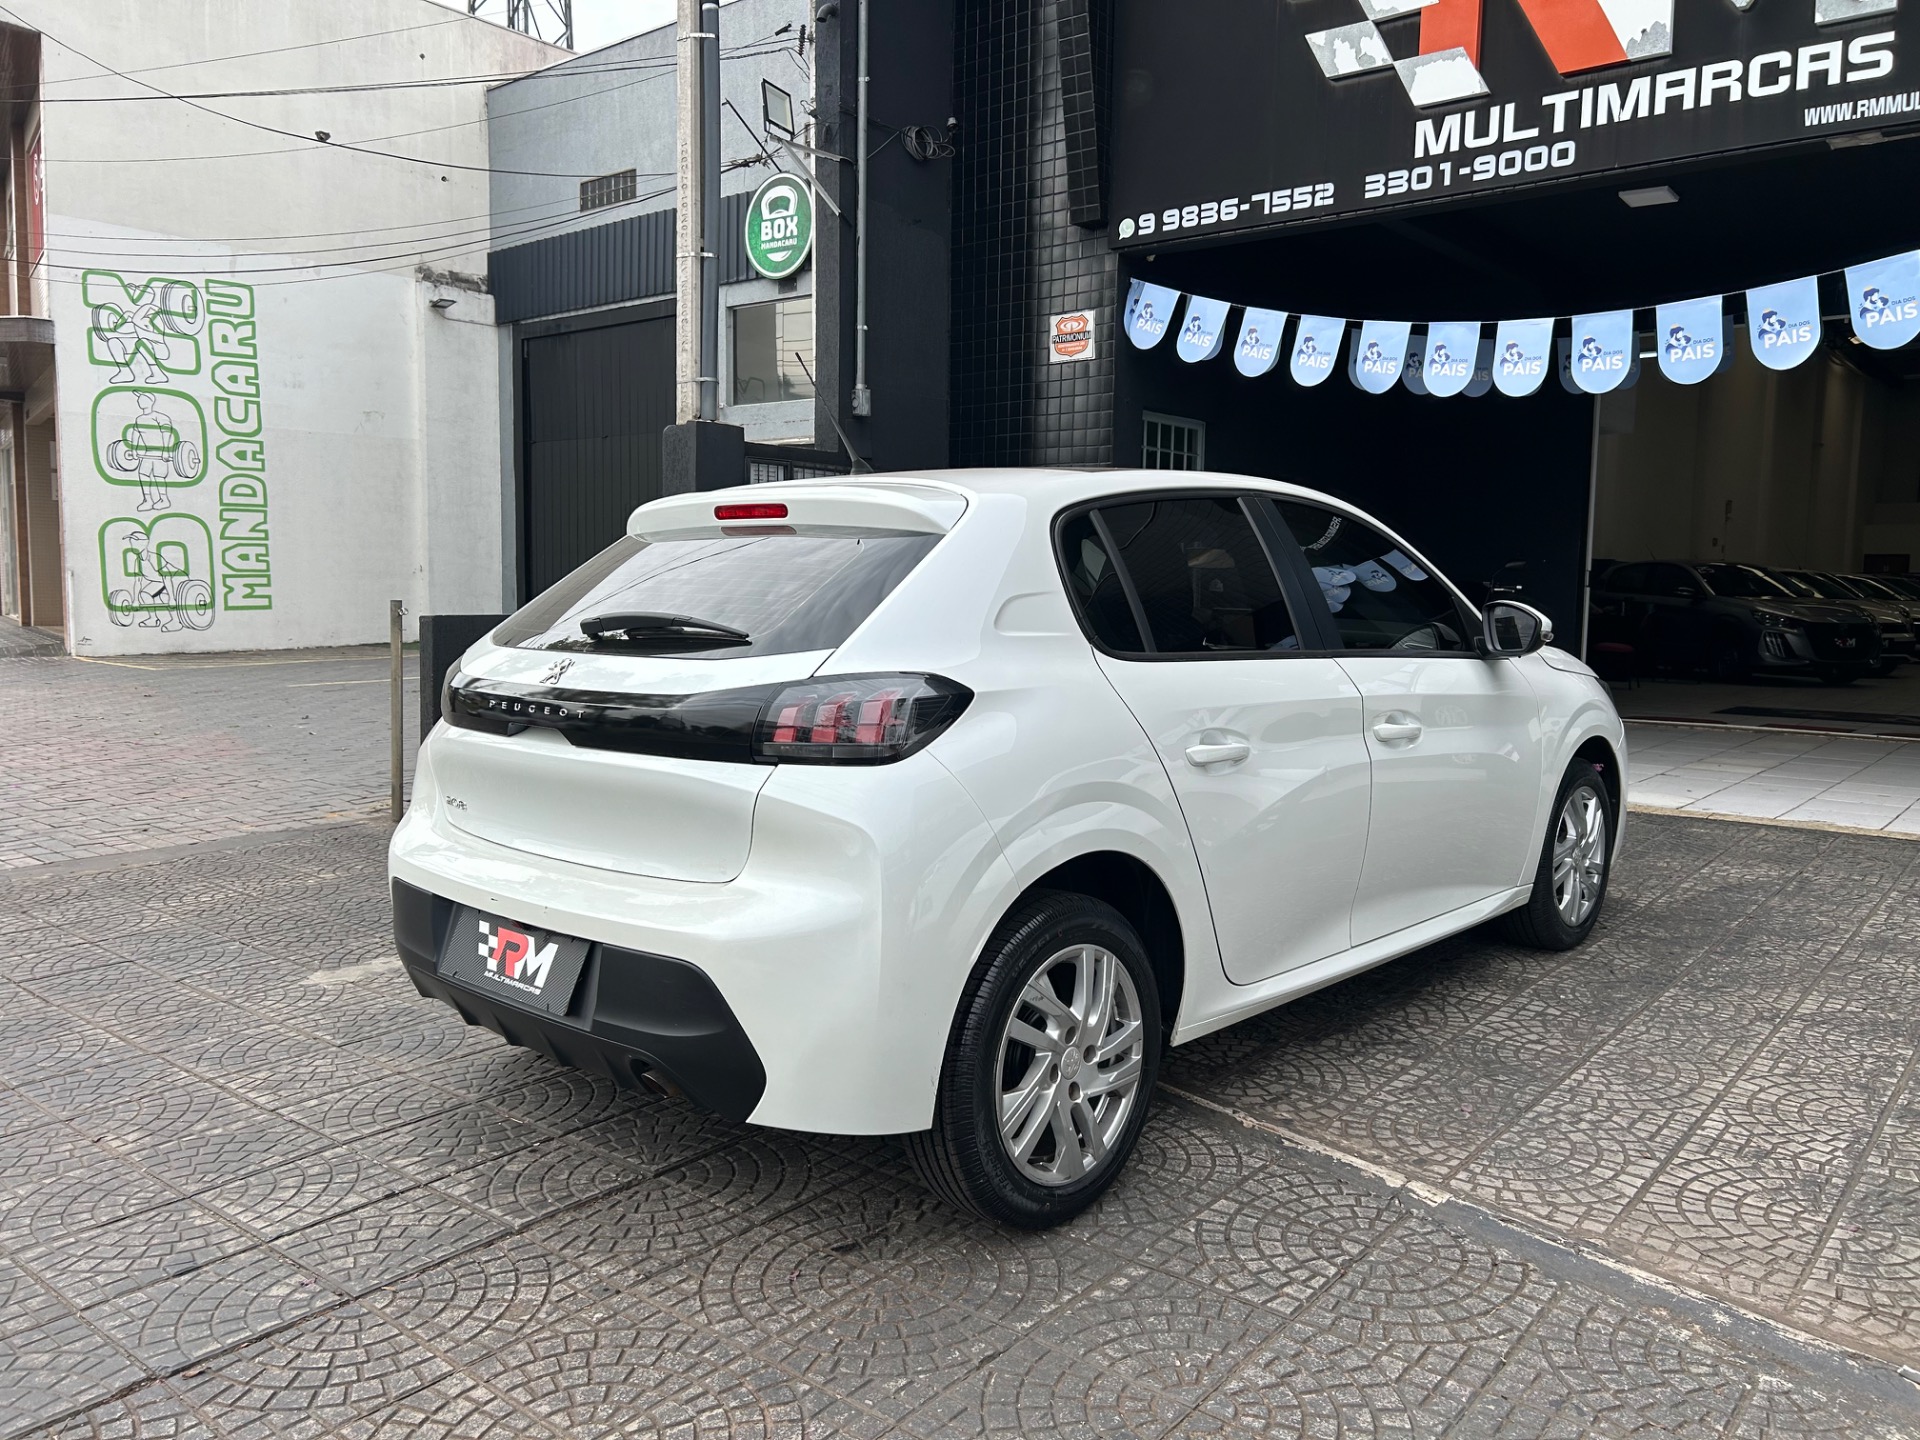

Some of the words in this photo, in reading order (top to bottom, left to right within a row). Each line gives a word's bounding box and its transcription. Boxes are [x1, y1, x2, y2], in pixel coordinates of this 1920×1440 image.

[1414, 30, 1896, 159] MULTIMARCAS
[1364, 140, 1576, 199] 3301-9000
[1137, 212, 1156, 236] 9
[1162, 182, 1335, 232] 9836-7552
[760, 215, 799, 241] BOX
[760, 238, 798, 250] MANDACARU
[1902, 295, 1916, 303] DOS
[1798, 319, 1811, 327] DOS
[1865, 302, 1919, 328] PAIS
[1136, 318, 1164, 335] PAIS
[1183, 331, 1214, 348] PAIS
[1763, 326, 1812, 349] PAIS
[1241, 344, 1272, 360] PAIS
[1297, 353, 1331, 369] PAIS
[1669, 343, 1716, 364] PAIS
[1363, 360, 1398, 375] PAIS
[1431, 363, 1469, 377] PAIS
[1502, 361, 1542, 376] PAIS
[1581, 356, 1624, 373] PAIS
[82, 269, 216, 613] BOX
[205, 278, 273, 612] MANDACARU
[488, 699, 585, 719] PEUGEOT
[492, 926, 559, 989] RM
[483, 970, 542, 996] MULTIMARCAS
